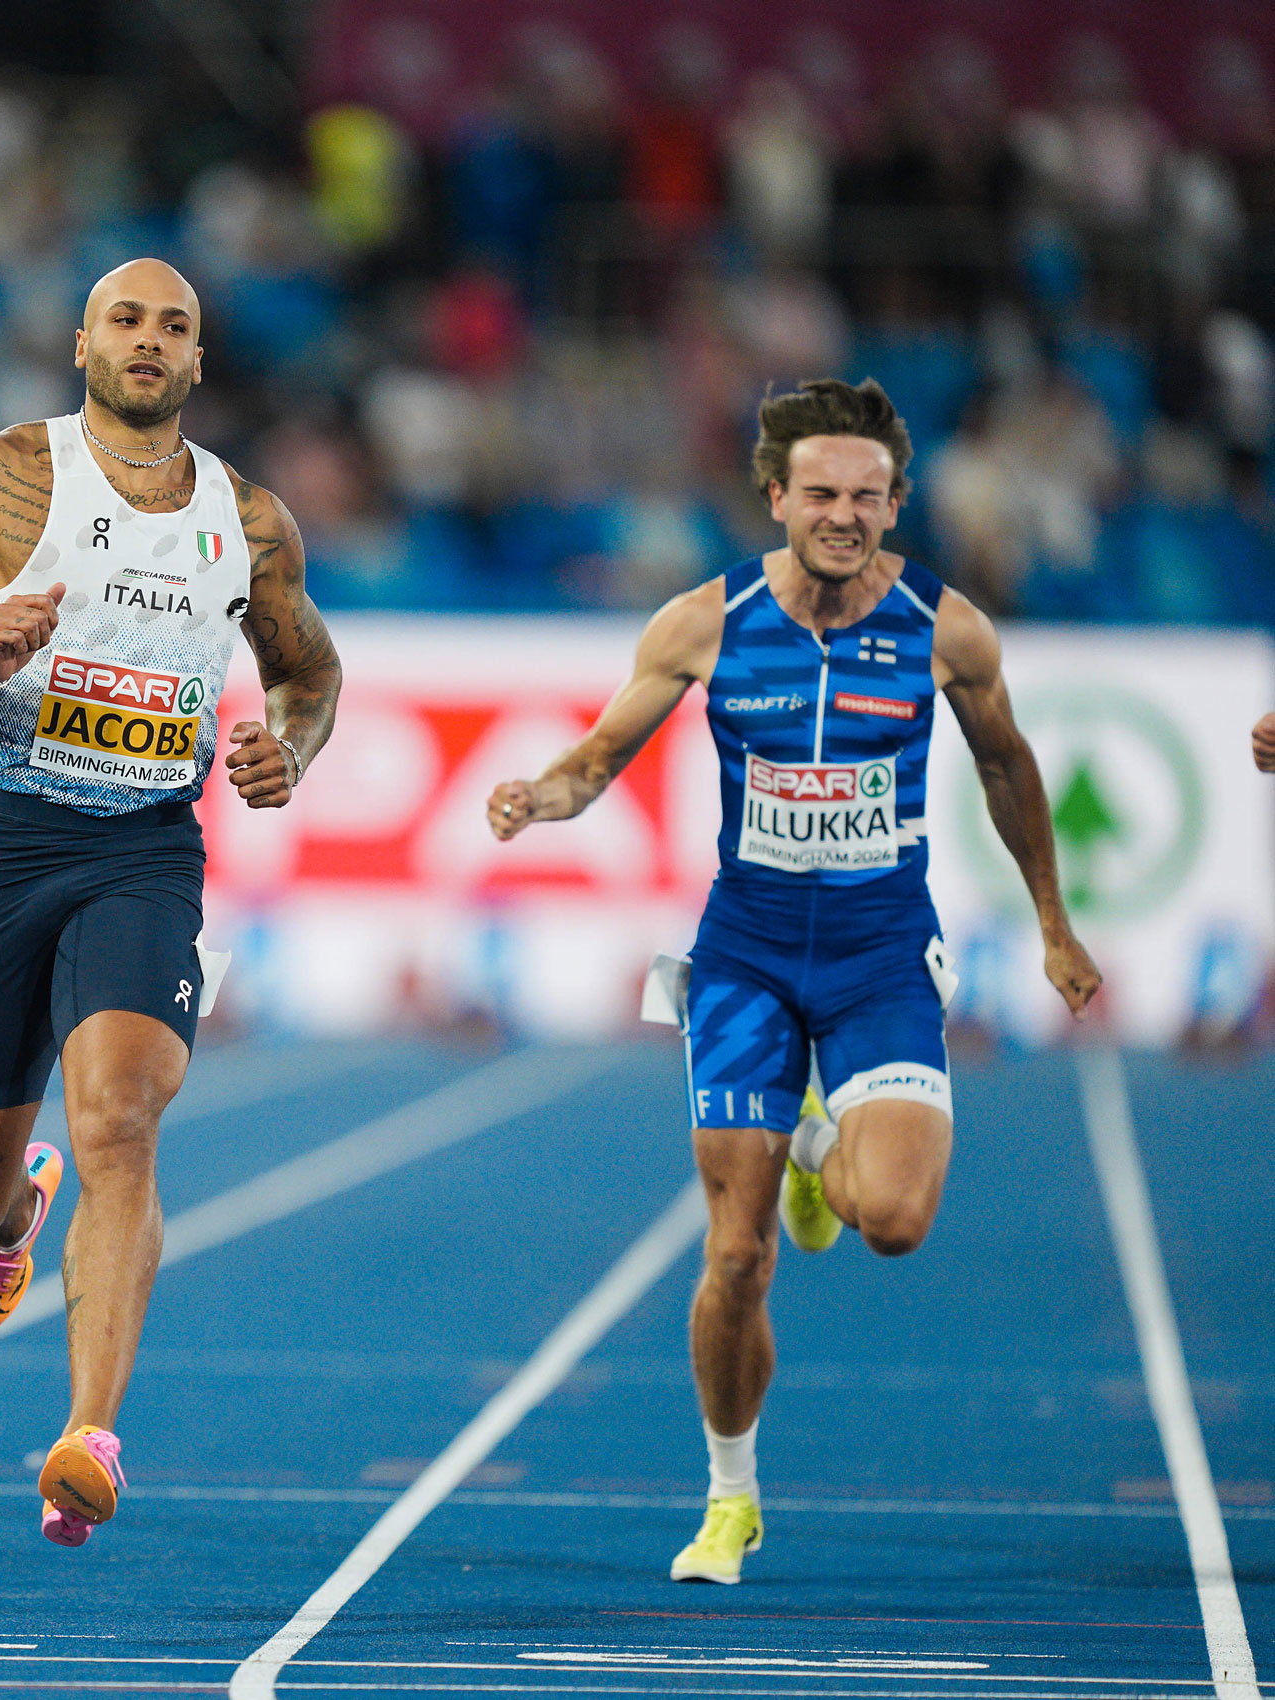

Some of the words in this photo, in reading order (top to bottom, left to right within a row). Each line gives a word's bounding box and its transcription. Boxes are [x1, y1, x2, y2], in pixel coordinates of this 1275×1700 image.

[123, 568, 187, 583] FRECCIAROSSA
[104, 583, 193, 616] ITALIA
[54, 662, 174, 708] SPAR
[725, 695, 789, 713] CRAFT
[837, 696, 915, 718] motonet
[41, 702, 193, 756] JACOBS
[38, 746, 153, 782] BIRMINGHAM
[153, 767, 187, 782] 2026
[751, 760, 855, 799] SPAR
[749, 799, 890, 842] ILLUKKA
[748, 841, 849, 865] BIRMINGHAM
[853, 850, 892, 864] 2026
[696, 1089, 765, 1121] FIN
